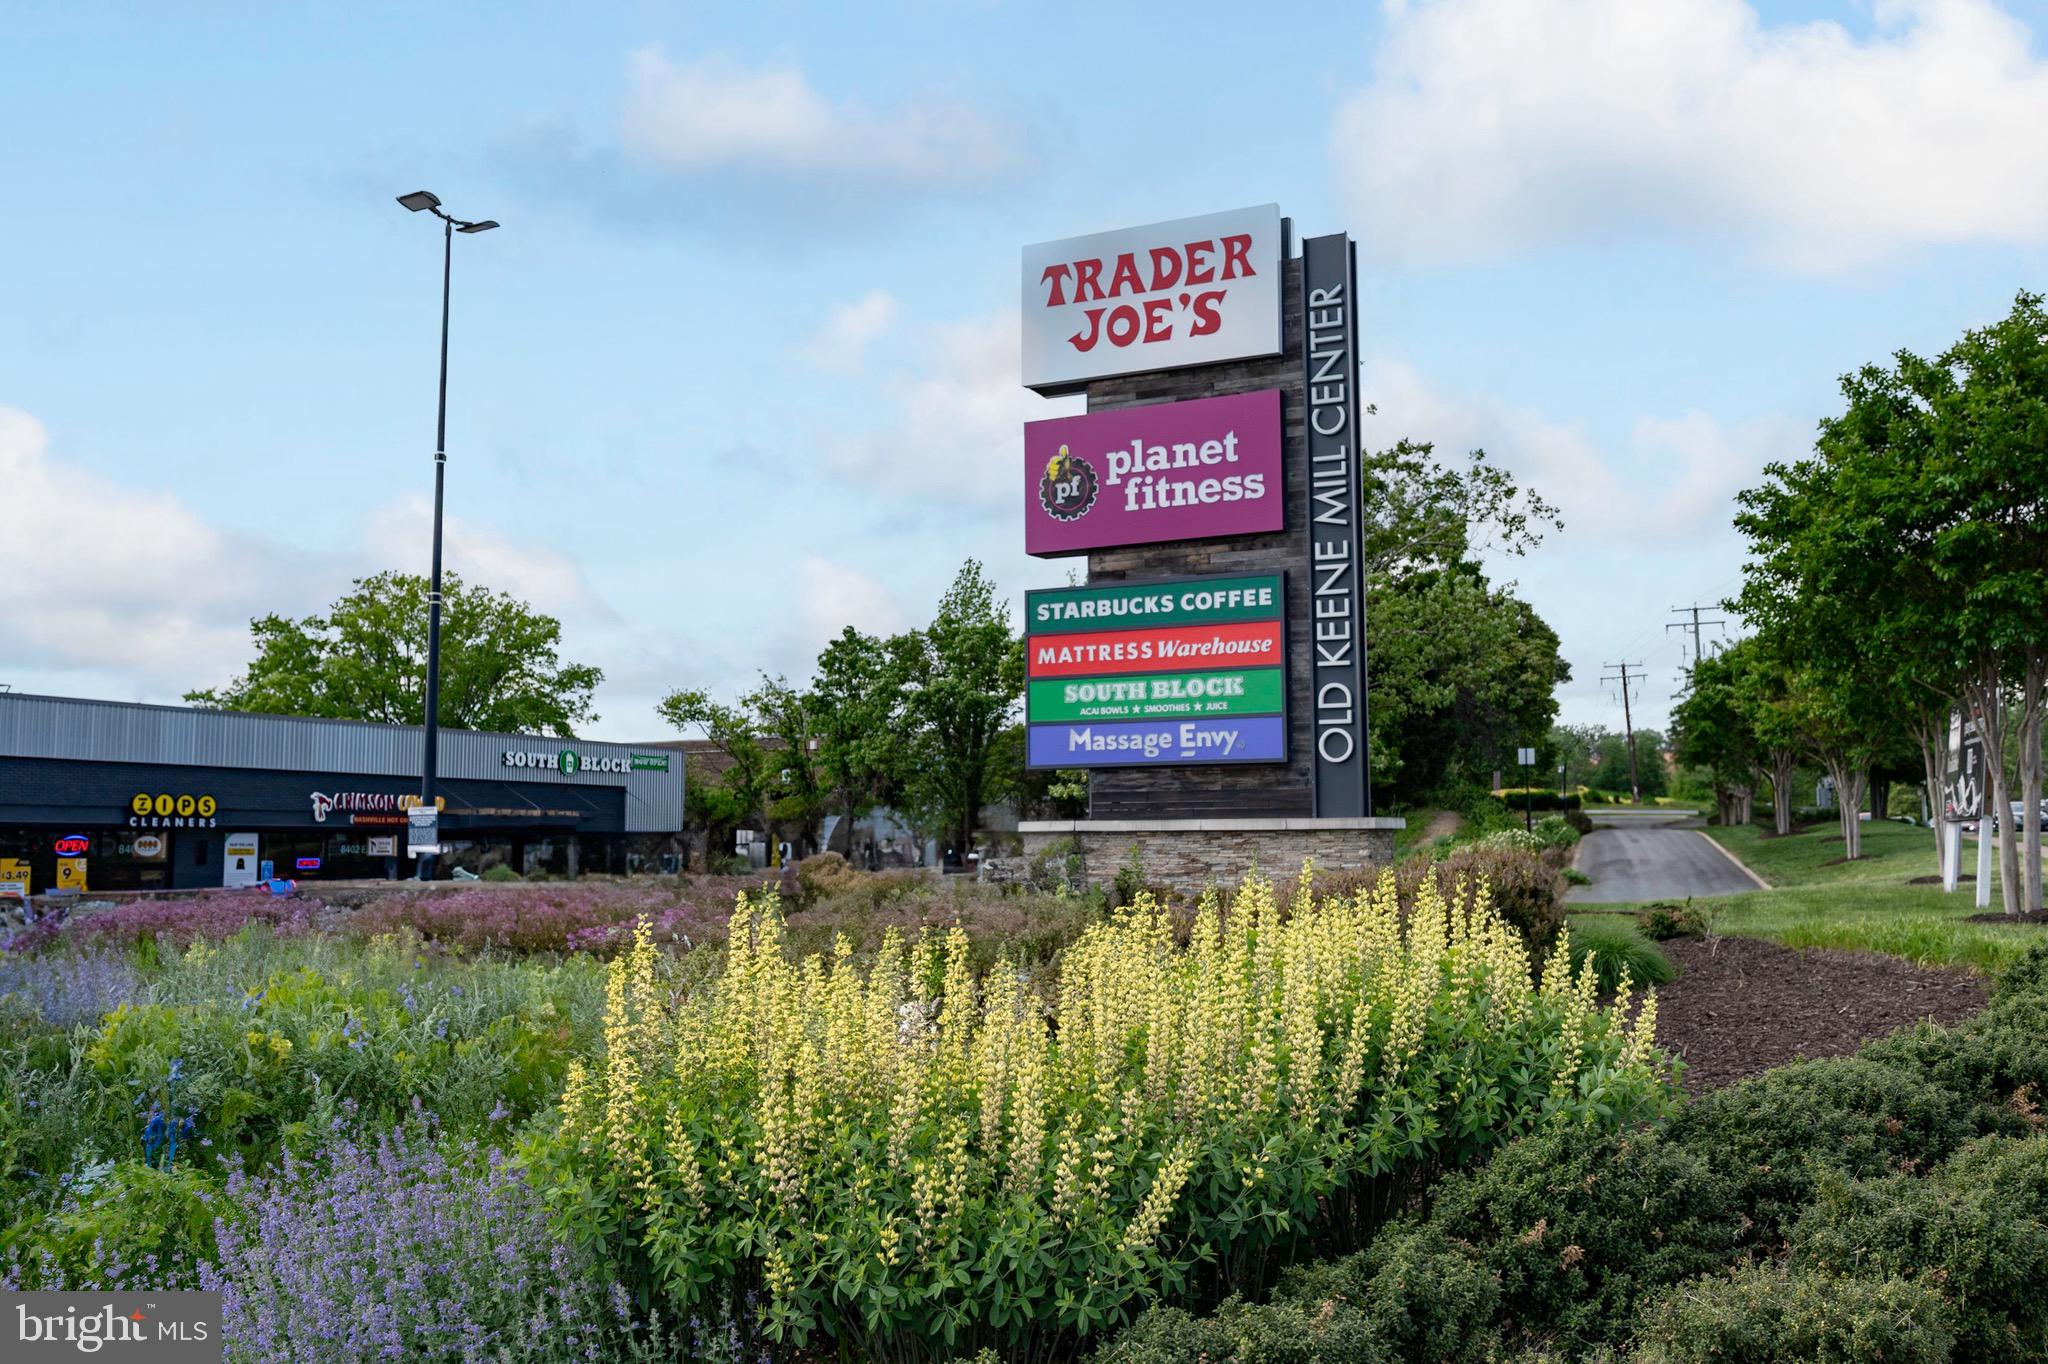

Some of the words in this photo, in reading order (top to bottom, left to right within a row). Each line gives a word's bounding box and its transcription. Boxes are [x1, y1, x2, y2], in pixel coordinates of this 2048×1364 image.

[1040, 234, 1257, 308] TRADER
[1067, 290, 1228, 353] JOE'S
[1309, 283, 1346, 436] CENTER
[1106, 430, 1239, 486] planet
[1055, 475, 1082, 505] pf
[1124, 473, 1266, 512] fitness
[1312, 444, 1348, 526] MILL
[1036, 594, 1174, 621] STARBUCKS
[1180, 587, 1273, 612] COFFEE
[1314, 539, 1351, 668] KEENE
[1037, 641, 1153, 665] MATTRESS
[1157, 637, 1273, 659] Warehouse
[1063, 680, 1147, 704] SOUTH
[1151, 675, 1245, 699] BLOCK
[1079, 707, 1100, 716] ACAI
[1100, 706, 1129, 715] BOWLS
[1143, 703, 1191, 713] SMOOTHIES
[1205, 701, 1229, 711] JUICE
[1318, 681, 1355, 764] OLD
[1068, 727, 1173, 758] Massage
[1179, 723, 1239, 757] Envy
[504, 750, 560, 770] SOUTH
[580, 756, 632, 773] BLOCK
[134, 795, 214, 815] ZIPS
[333, 792, 395, 811] CRIMSON
[129, 816, 217, 828] CLEANERS
[353, 815, 385, 825] NASHVILLE
[386, 816, 399, 825] HOT
[55, 838, 89, 852] OPEN
[62, 867, 72, 880] 9
